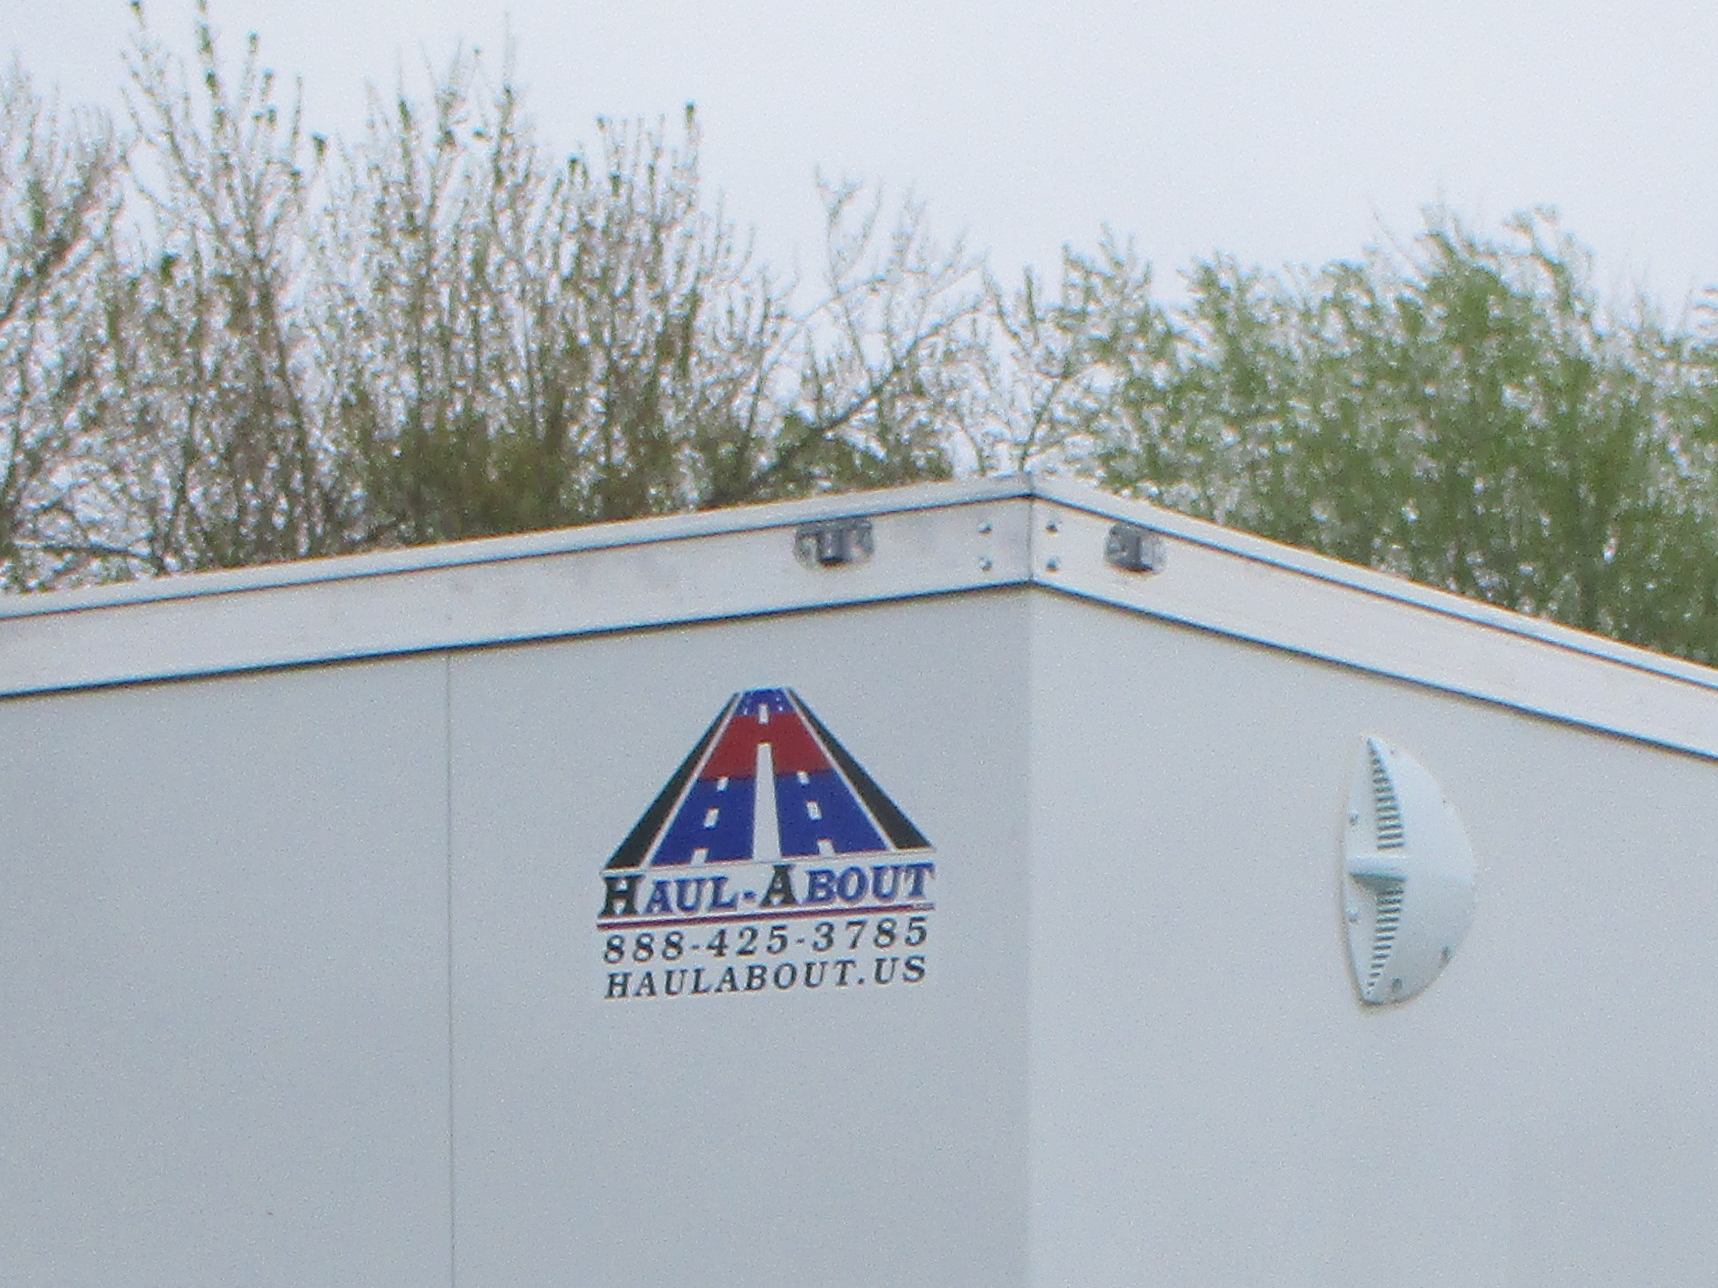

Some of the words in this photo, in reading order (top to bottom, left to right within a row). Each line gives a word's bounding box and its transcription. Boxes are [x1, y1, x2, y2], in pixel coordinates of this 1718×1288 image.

[597, 861, 935, 917] HAUL-ABOUT
[604, 915, 928, 964] 888-425-3785
[604, 953, 926, 999] HAULABOUT.US
